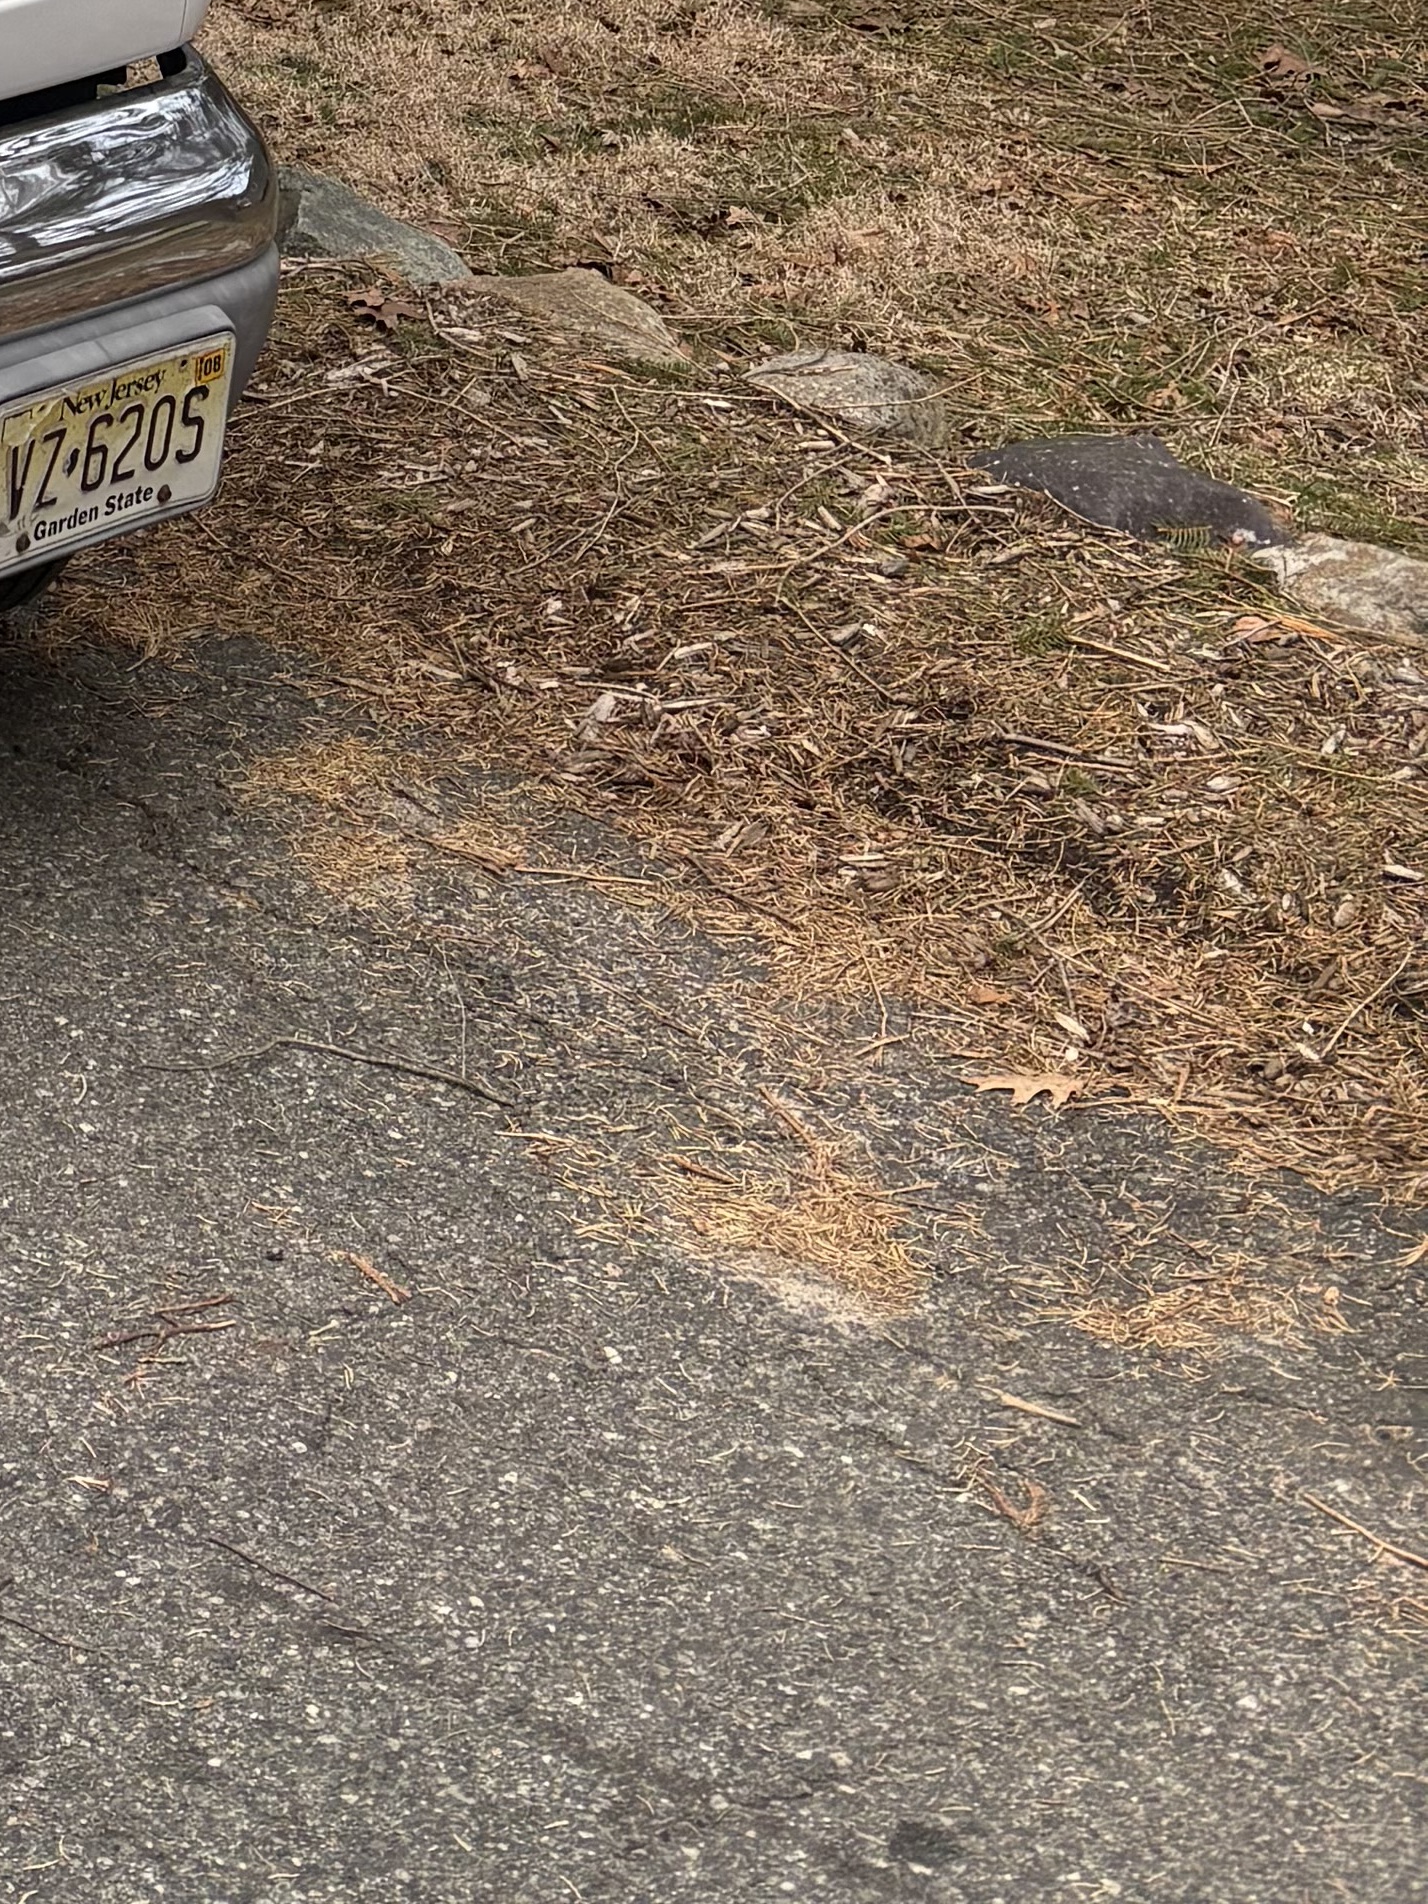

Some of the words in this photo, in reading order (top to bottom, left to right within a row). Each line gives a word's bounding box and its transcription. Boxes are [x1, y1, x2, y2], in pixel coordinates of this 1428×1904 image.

[60, 391, 105, 421] New
[104, 368, 167, 410] Jersey
[33, 504, 99, 541] Garden
[104, 485, 154, 516] State
